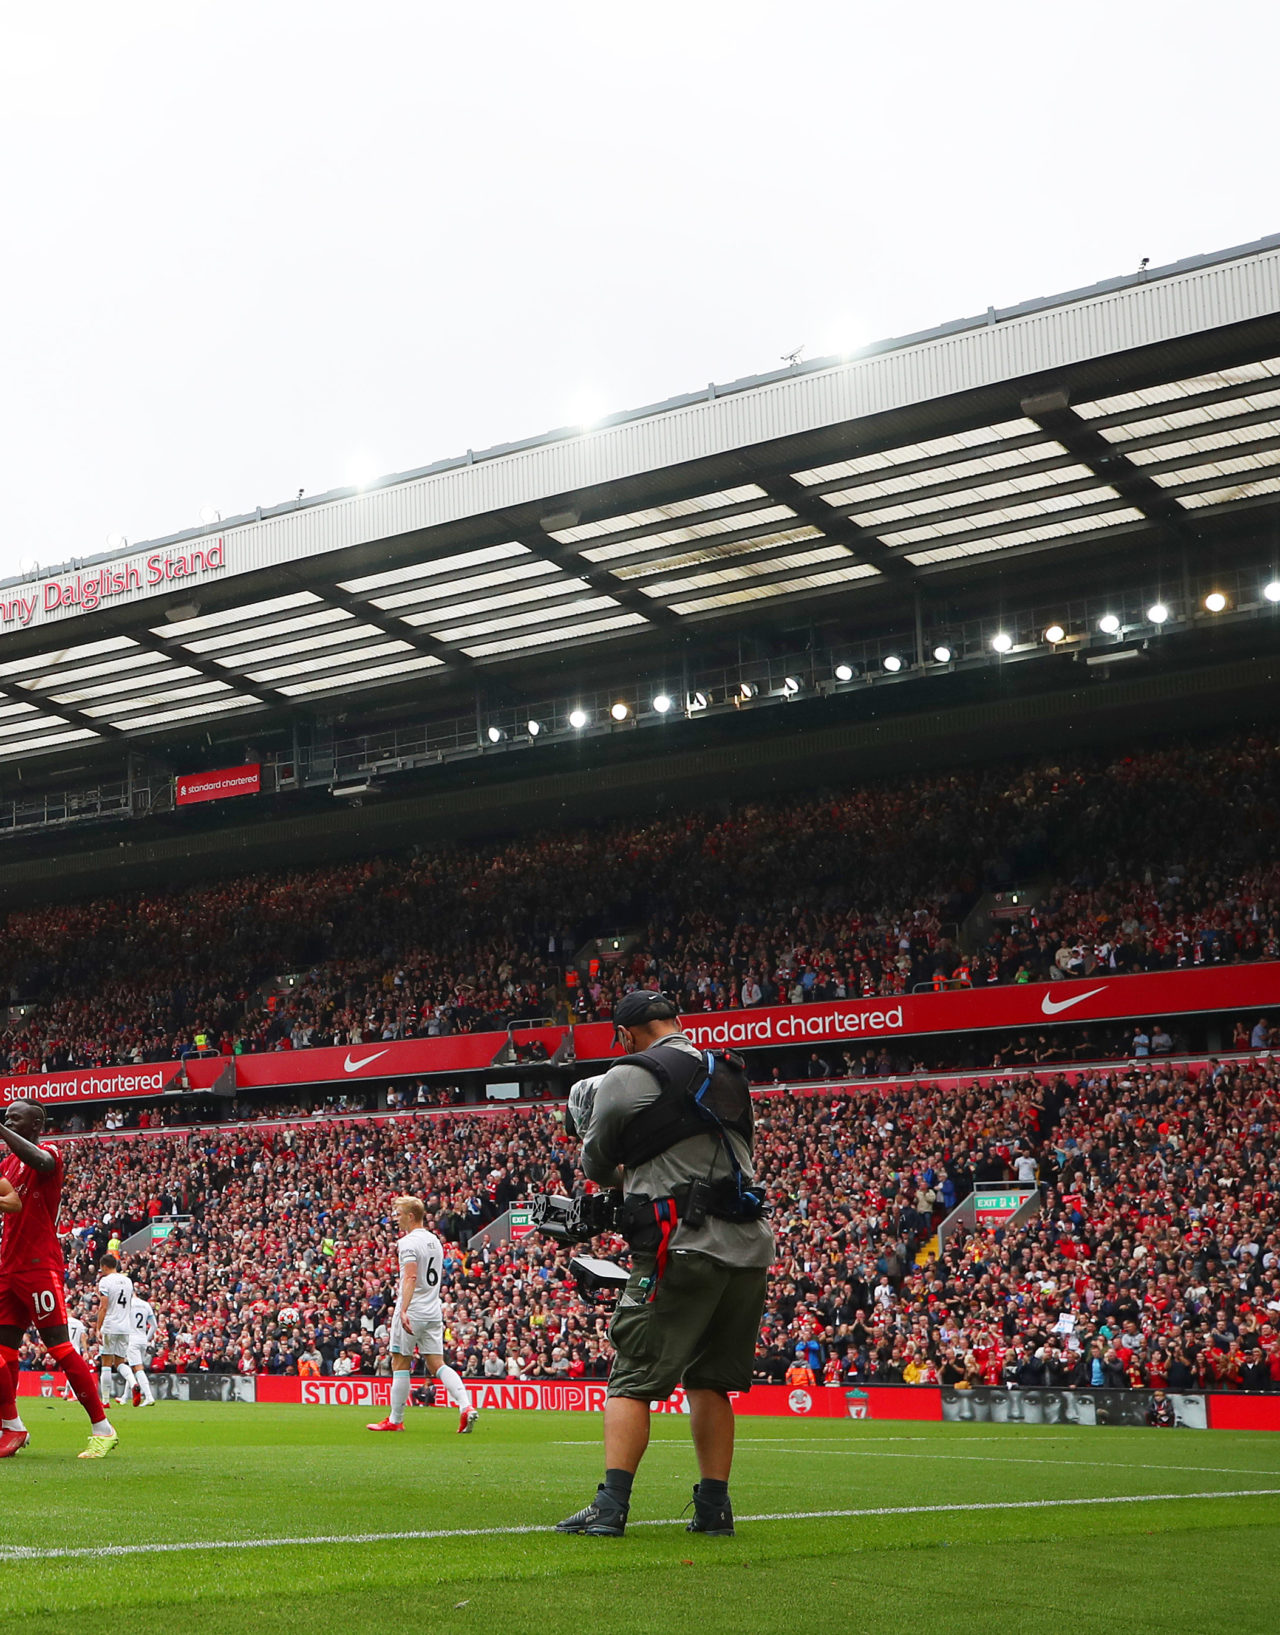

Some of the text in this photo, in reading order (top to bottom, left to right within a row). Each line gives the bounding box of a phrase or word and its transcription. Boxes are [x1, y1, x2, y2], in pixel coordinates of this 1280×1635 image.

[44, 563, 140, 610] Dalglish
[147, 538, 224, 584] Stand
[188, 774, 258, 794] standard chartered
[776, 1006, 903, 1037] chartered
[3, 1071, 163, 1101] standard chartered
[977, 1199, 997, 1207] EXIT
[426, 1257, 438, 1287] 6
[32, 1290, 55, 1314] 10
[117, 1289, 127, 1309] 4
[135, 1313, 143, 1328] 2
[71, 1327, 77, 1340] 7
[304, 1382, 369, 1405] STOP
[542, 1386, 584, 1411] UP
